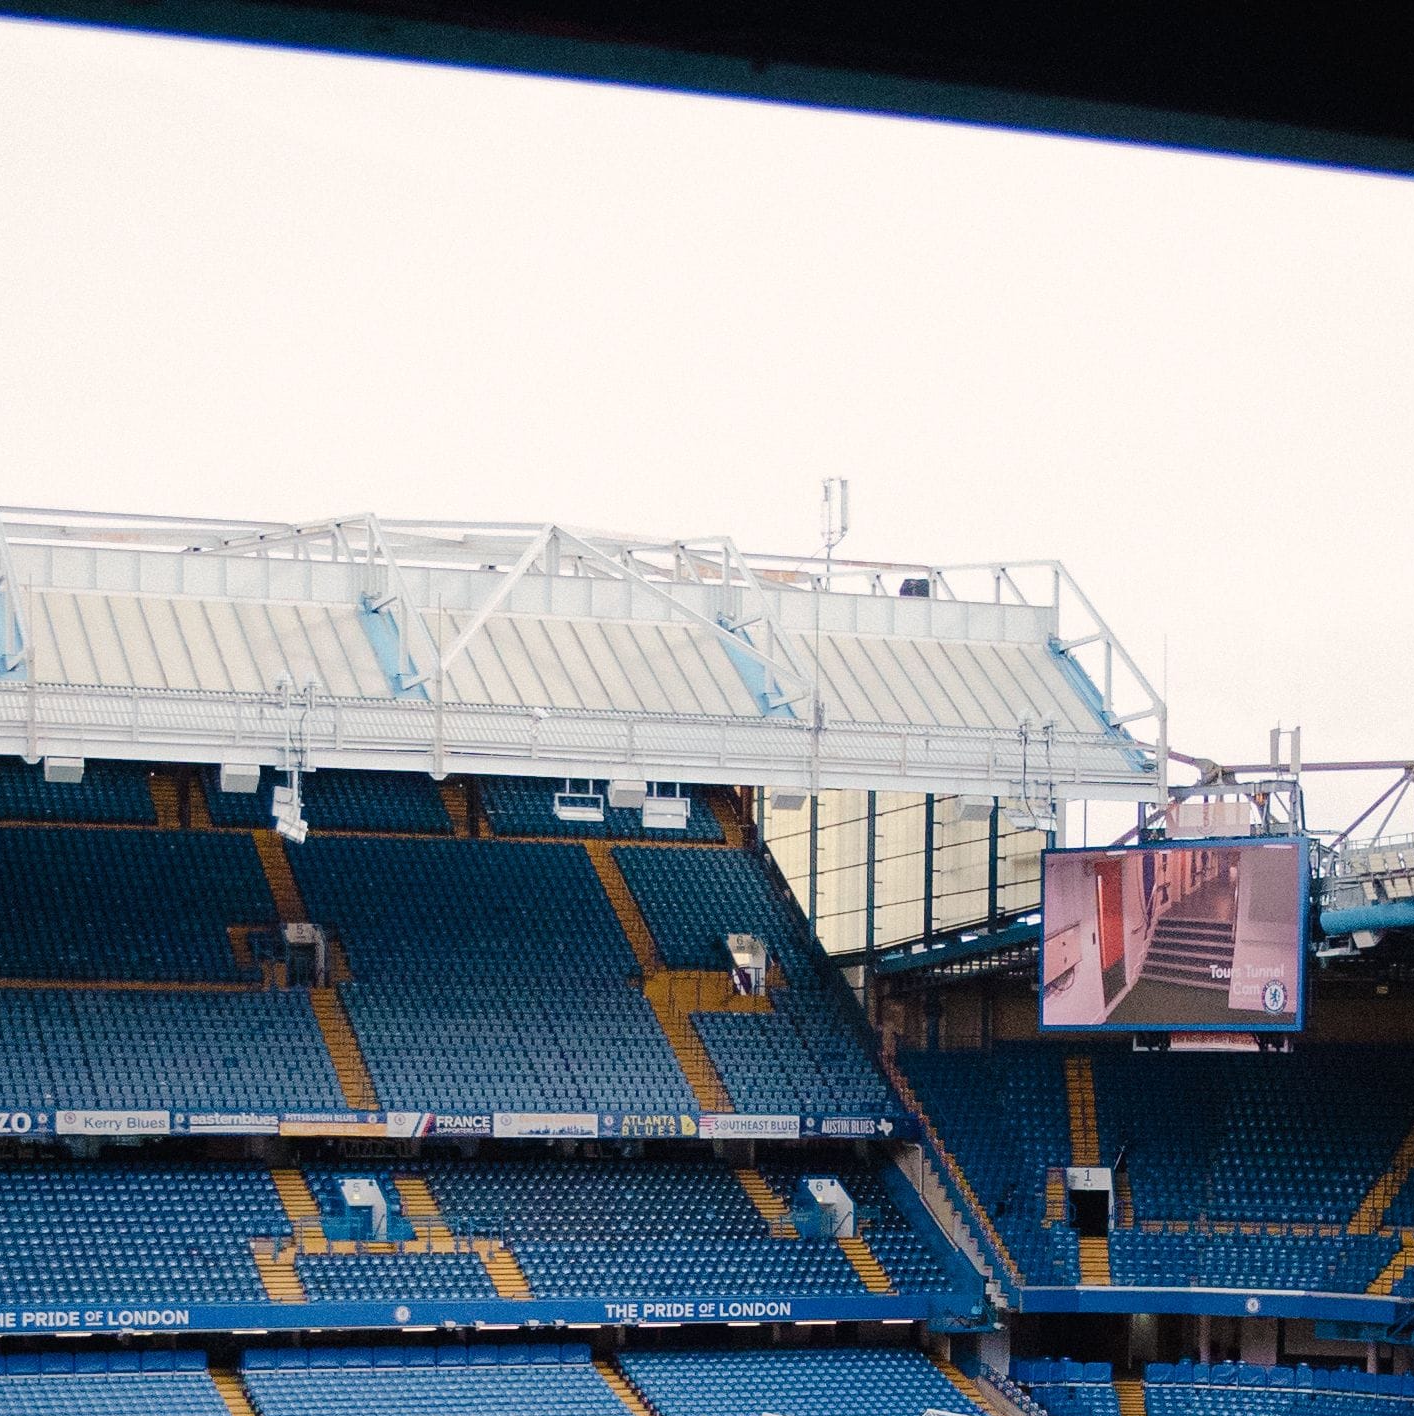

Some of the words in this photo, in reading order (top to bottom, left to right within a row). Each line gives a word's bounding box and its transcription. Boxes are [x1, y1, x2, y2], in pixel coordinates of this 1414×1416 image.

[1209, 965, 1240, 979] Tours
[1245, 964, 1285, 978] Tunnel
[84, 1117, 121, 1130] Kerry
[127, 1117, 166, 1128] Blues
[436, 1115, 491, 1128] FRANCE
[622, 1115, 676, 1127] ATLANTA
[771, 1119, 798, 1131] BLUES
[821, 1119, 850, 1134] AUSTIN
[851, 1119, 876, 1134] BLUES
[621, 1126, 676, 1137] BLUES
[605, 1304, 638, 1319] THE
[643, 1303, 694, 1318] PRIDE
[698, 1303, 715, 1314] OF
[719, 1301, 791, 1317] LONDON
[22, 1311, 80, 1327] PRIDE
[85, 1311, 103, 1322] OF
[108, 1309, 189, 1326] LONDON
